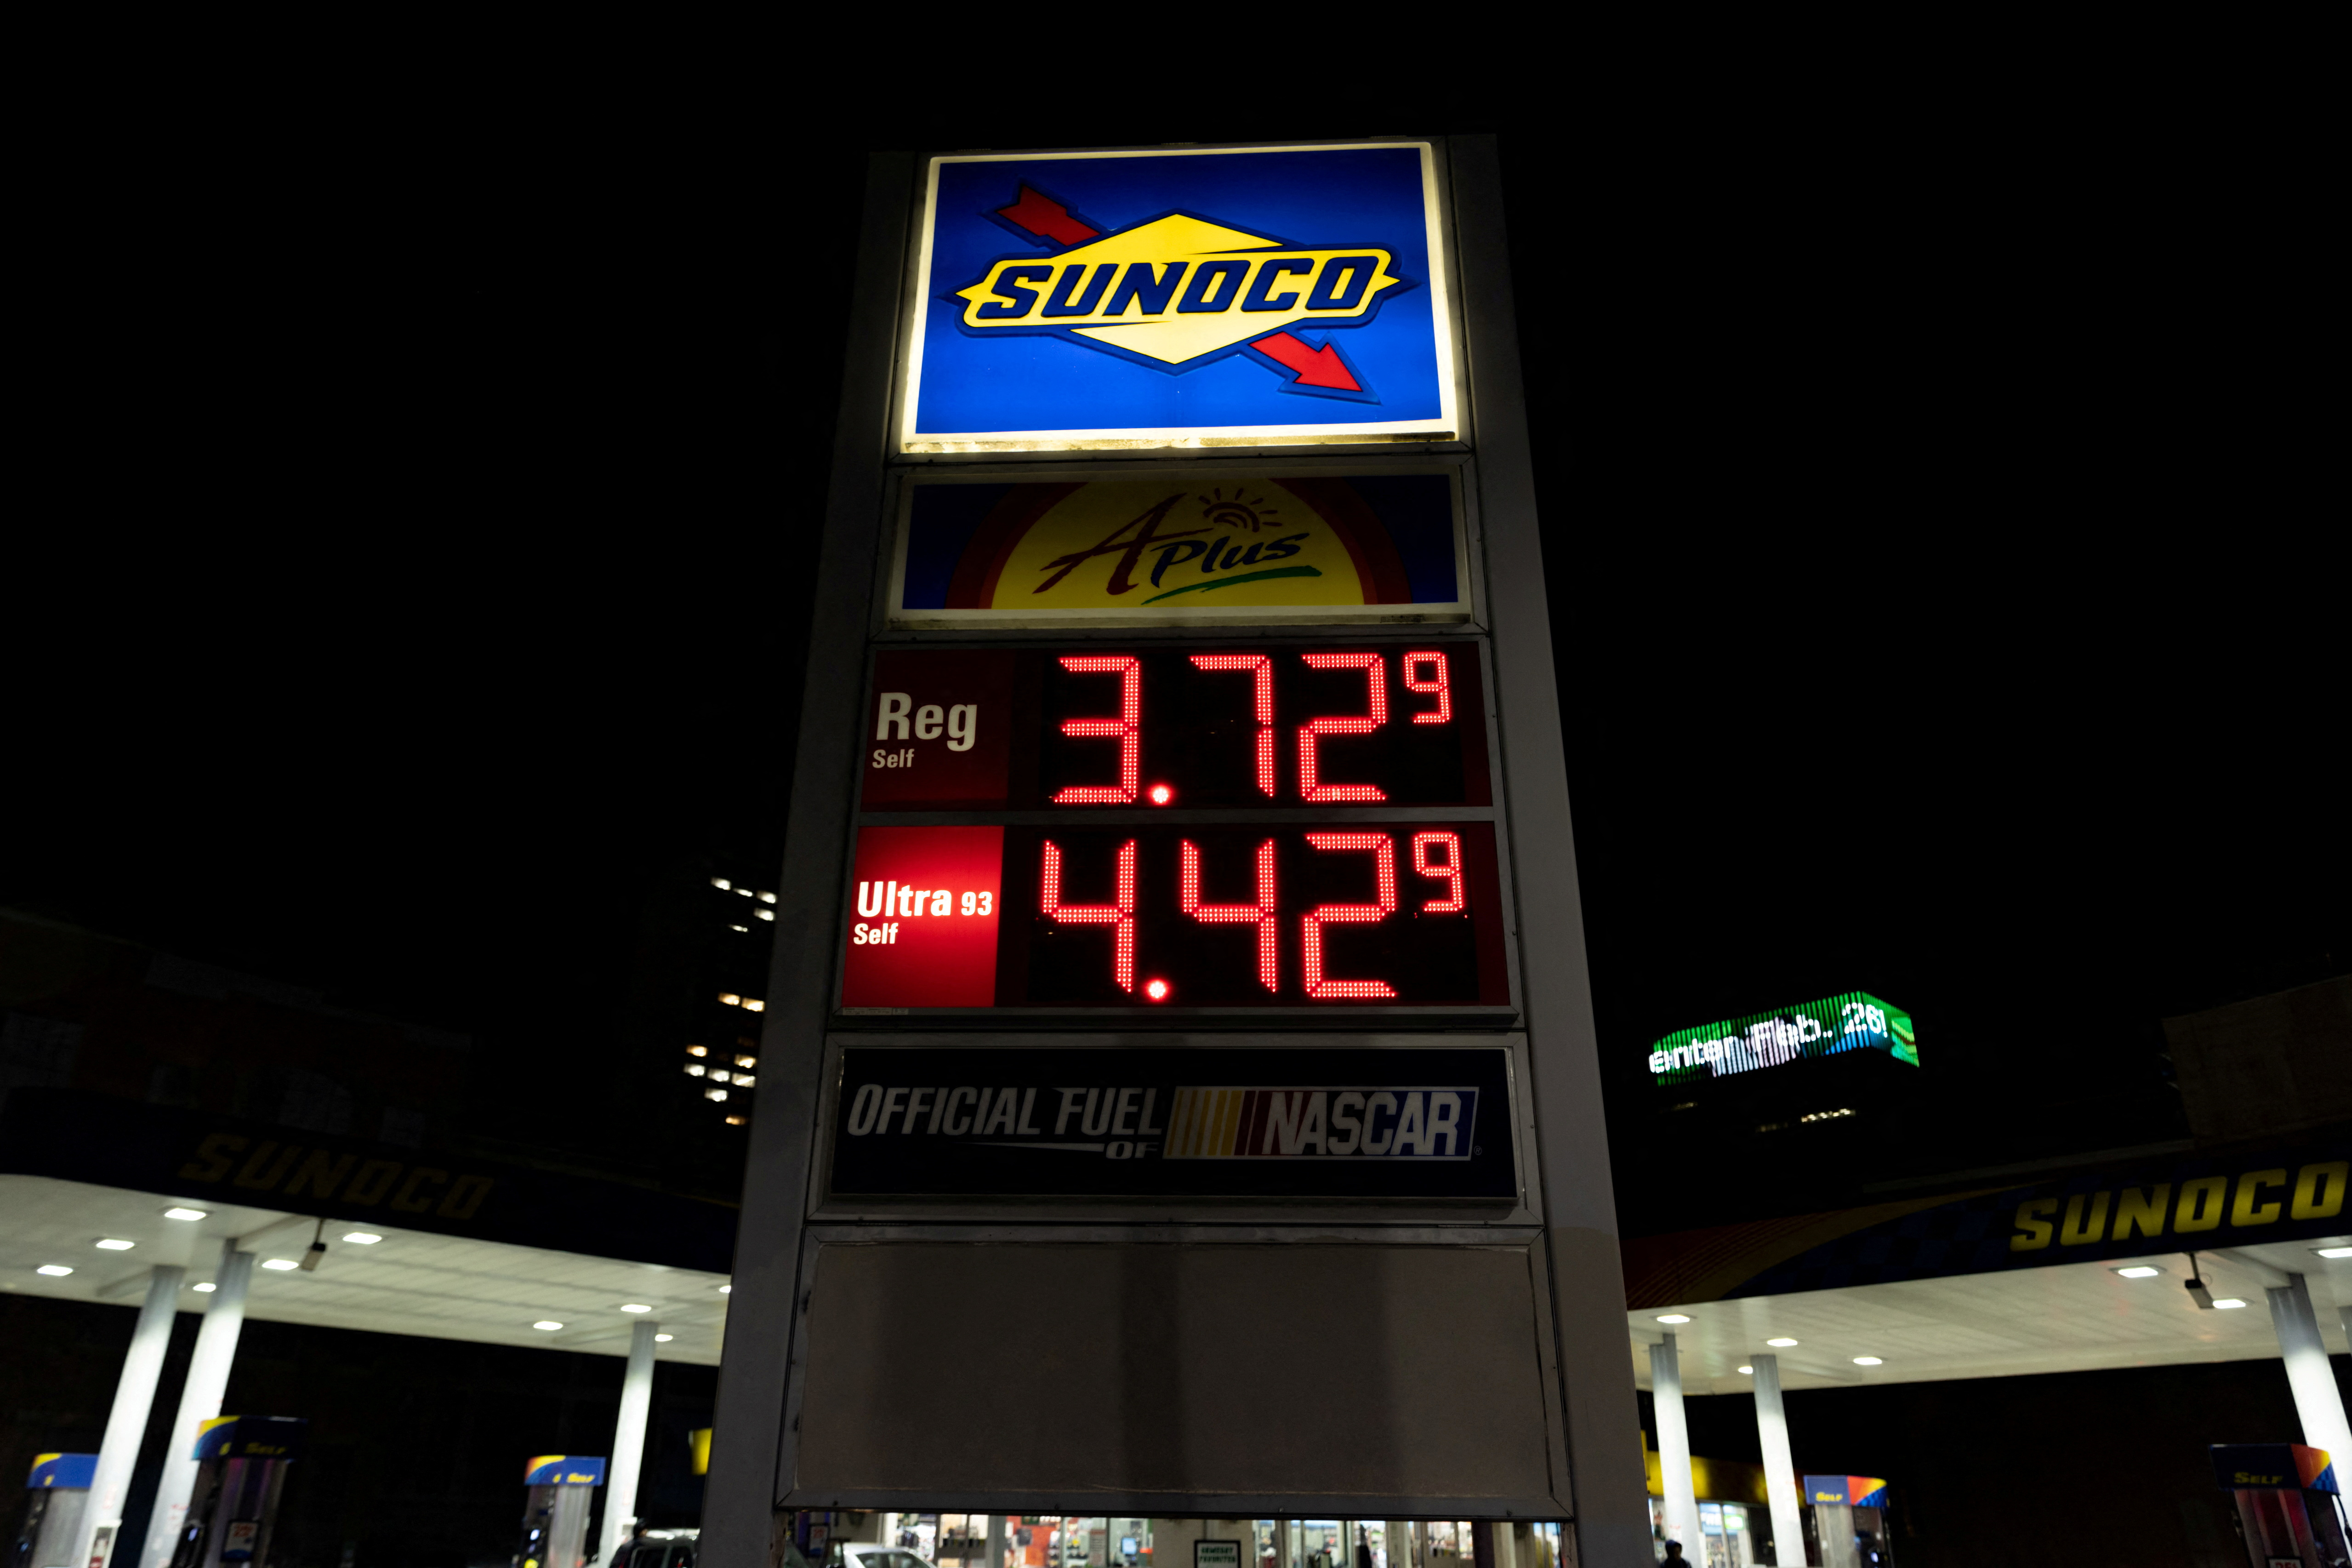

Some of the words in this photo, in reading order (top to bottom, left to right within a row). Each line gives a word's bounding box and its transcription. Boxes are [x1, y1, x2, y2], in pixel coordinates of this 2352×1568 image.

[976, 255, 1379, 320] SUNOCO
[876, 692, 977, 752] Reg
[872, 748, 915, 769] Self
[857, 881, 952, 918] Ultra
[961, 891, 993, 916] 93
[853, 922, 899, 945] Self
[847, 1083, 1042, 1136] OFFICIAL
[1051, 1087, 1163, 1136] FUEL
[1261, 1091, 1462, 1156] NASCAR
[177, 1131, 495, 1220] SUNOCO
[1105, 1140, 1159, 1160] OF
[2009, 1159, 2351, 1253] SUNOCO
